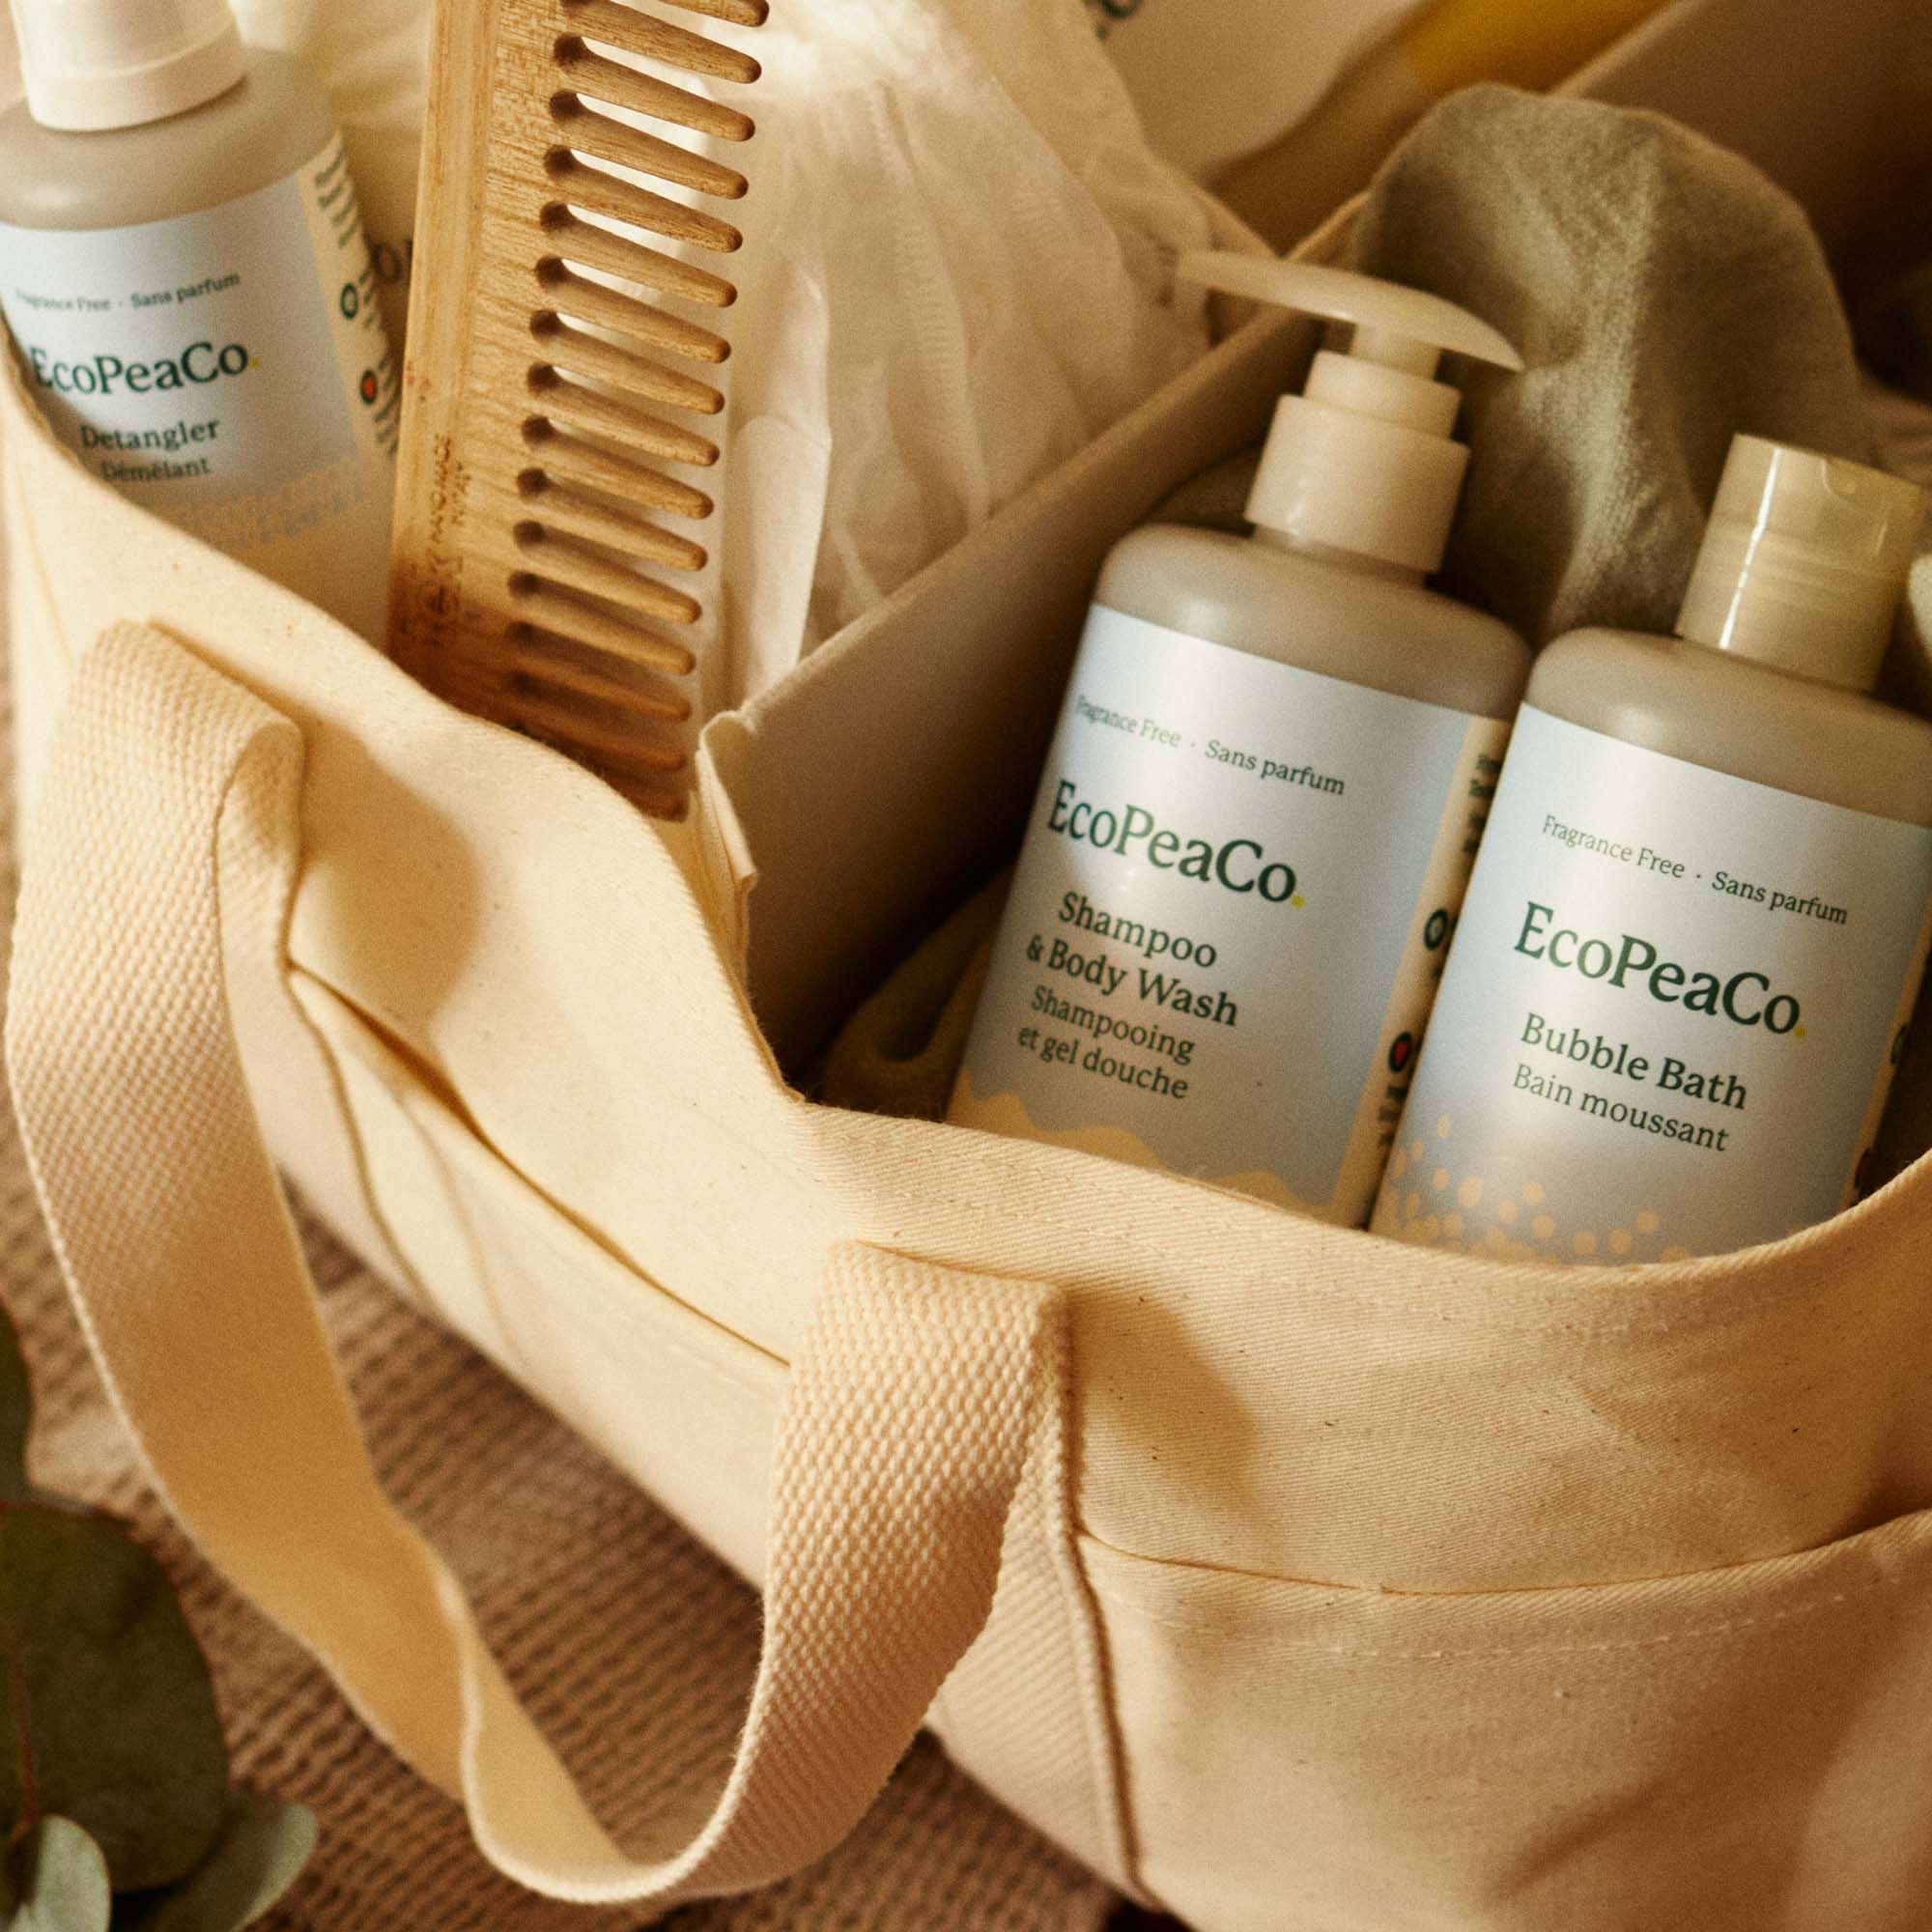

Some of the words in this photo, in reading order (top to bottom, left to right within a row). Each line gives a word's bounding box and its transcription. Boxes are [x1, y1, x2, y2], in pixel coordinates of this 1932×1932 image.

[76, 296, 110, 313] Free
[129, 291, 172, 309] Sans
[175, 273, 240, 303] parfum
[79, 419, 220, 452] Detangler
[1077, 695, 1137, 734] Fragrance
[1139, 719, 1182, 749] Free
[1204, 739, 1258, 772] Sans
[1259, 757, 1346, 797] parfum
[1542, 814, 1634, 864] Fragrance
[1635, 846, 1687, 880] Free
[1710, 869, 1767, 904] Sans
[1769, 889, 1849, 926] parfum
[1057, 890, 1218, 969] Shampoo
[1026, 933, 1045, 963] &
[1047, 937, 1129, 997] Body
[1138, 966, 1238, 1028] Wash
[1017, 1026, 1041, 1051] et
[1039, 1037, 1081, 1065] gel
[1082, 1046, 1189, 1100] douche
[1030, 983, 1197, 1066] Shampooing
[1520, 1011, 1649, 1081] Bubble
[1655, 1056, 1749, 1111] Bath
[1512, 1063, 1573, 1107] Bain
[1578, 1090, 1730, 1153] moussant
